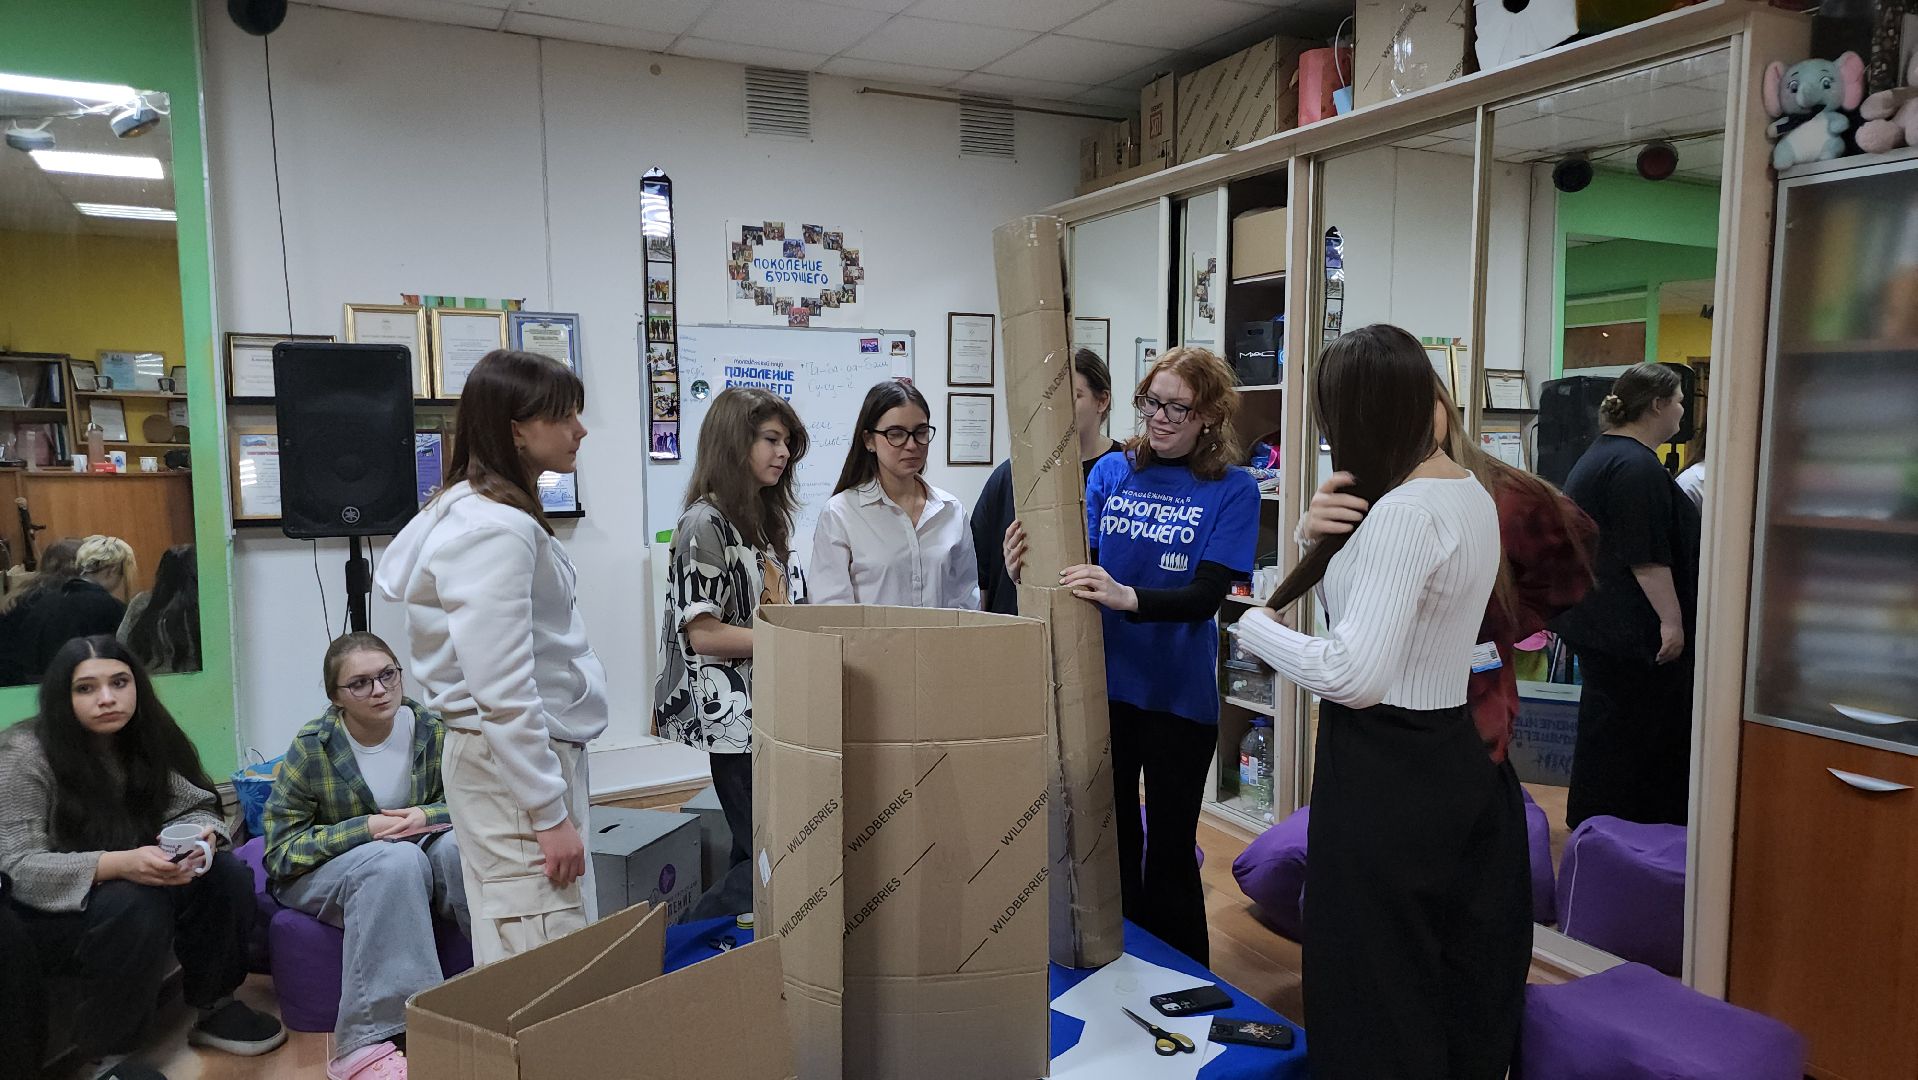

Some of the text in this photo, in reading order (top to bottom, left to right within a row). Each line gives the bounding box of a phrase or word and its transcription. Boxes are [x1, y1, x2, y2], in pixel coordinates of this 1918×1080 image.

[753, 258, 823, 272] ПОКОЛЕНИЕ
[724, 366, 795, 382] ПОКОЛЕНИЕ
[786, 798, 839, 855] WILDBERRIES
[848, 788, 914, 854] WILDBERRIES
[778, 886, 829, 939] WILDBERRIES
[989, 866, 1050, 936] WILDBERRIES
